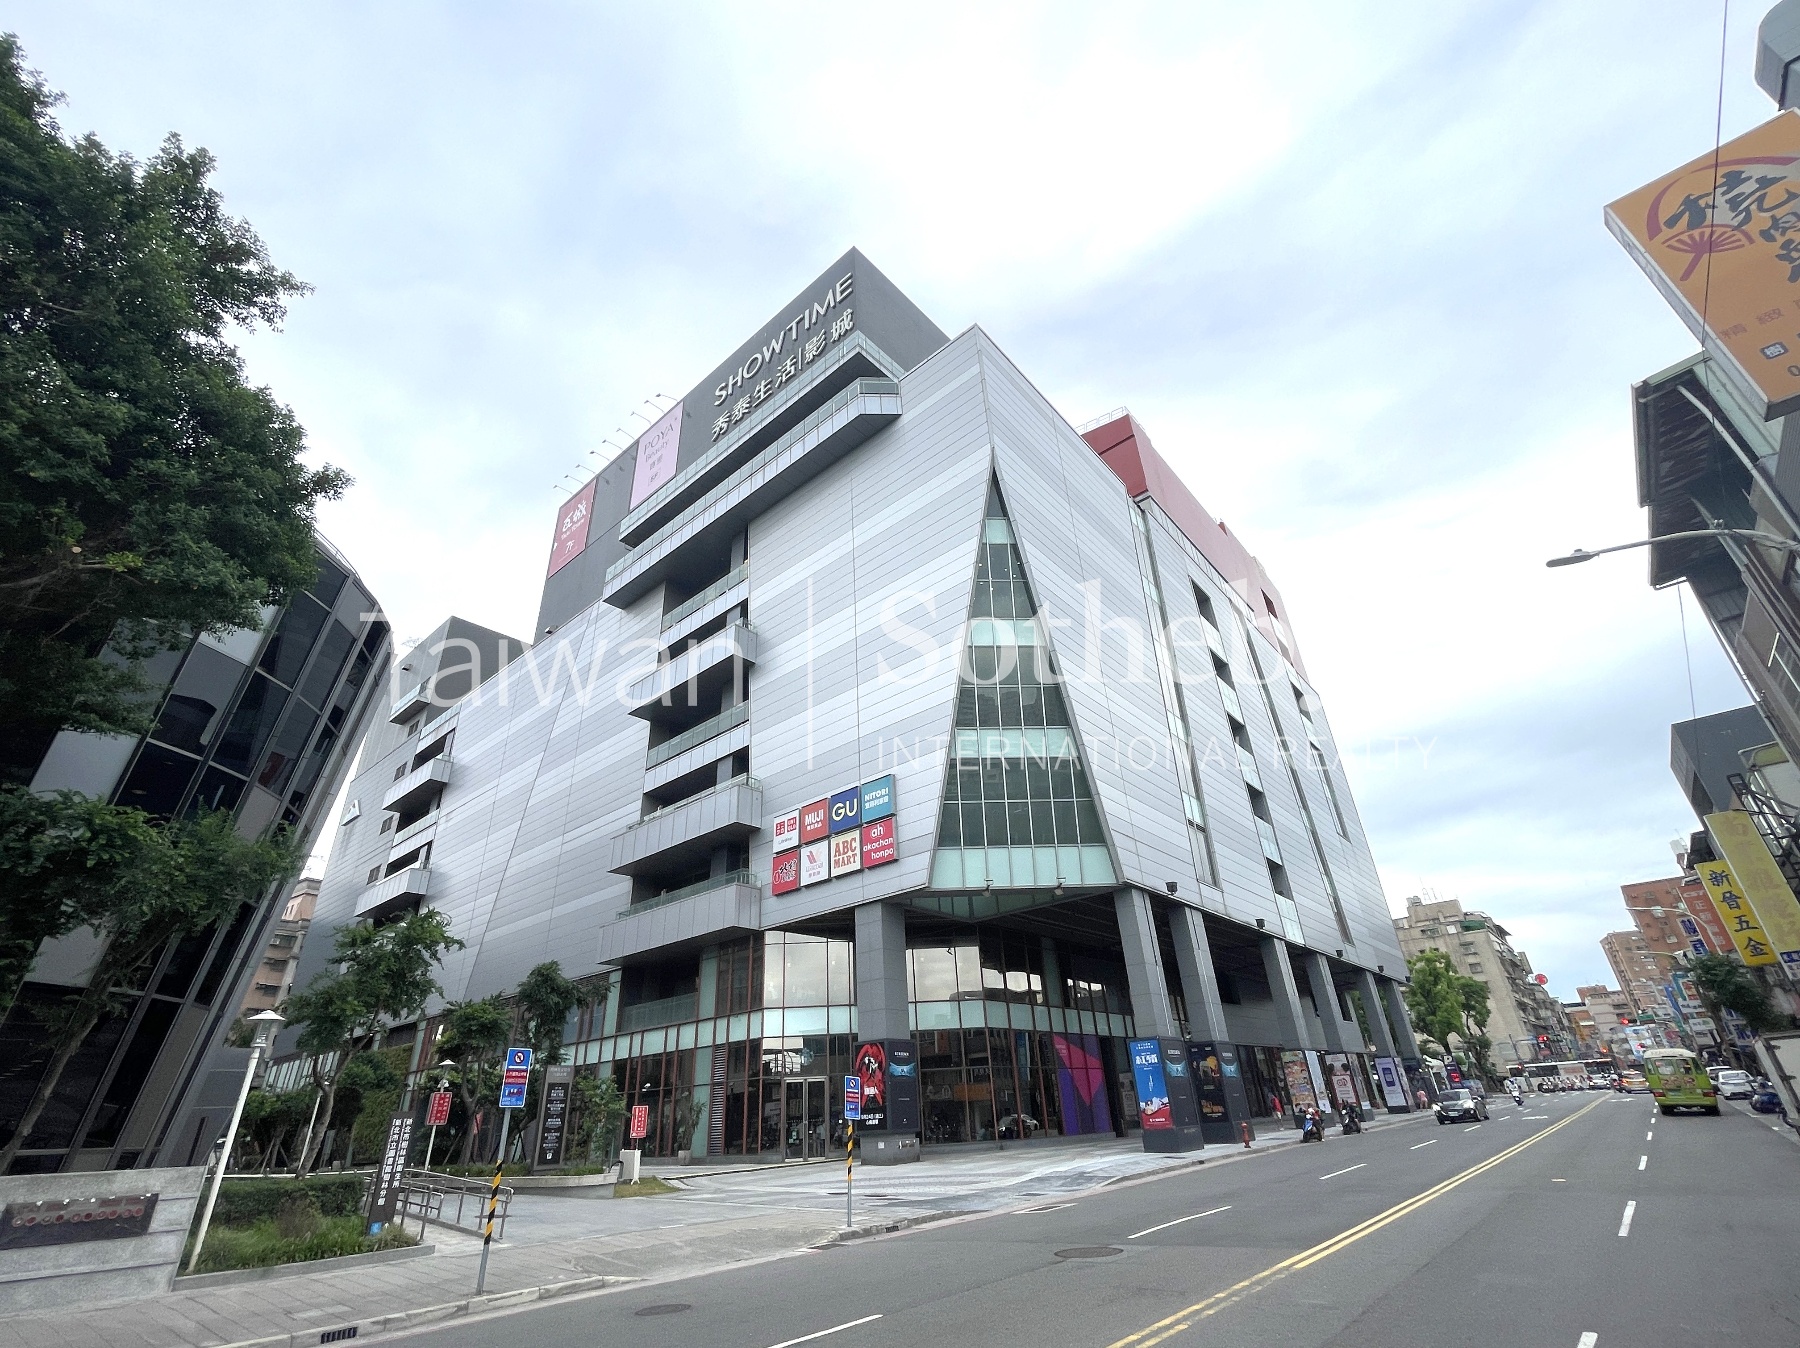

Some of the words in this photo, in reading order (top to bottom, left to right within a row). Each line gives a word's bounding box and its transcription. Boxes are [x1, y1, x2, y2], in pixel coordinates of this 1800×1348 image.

[713, 272, 854, 406] SHOWTIME
[644, 423, 674, 455] POYA
[864, 787, 888, 801] NITORI
[805, 809, 824, 825] MUJI
[832, 798, 857, 821] GU
[834, 837, 857, 858] ABC
[863, 837, 894, 852] akachan
[833, 853, 858, 869] MART
[871, 847, 894, 860] honpo
